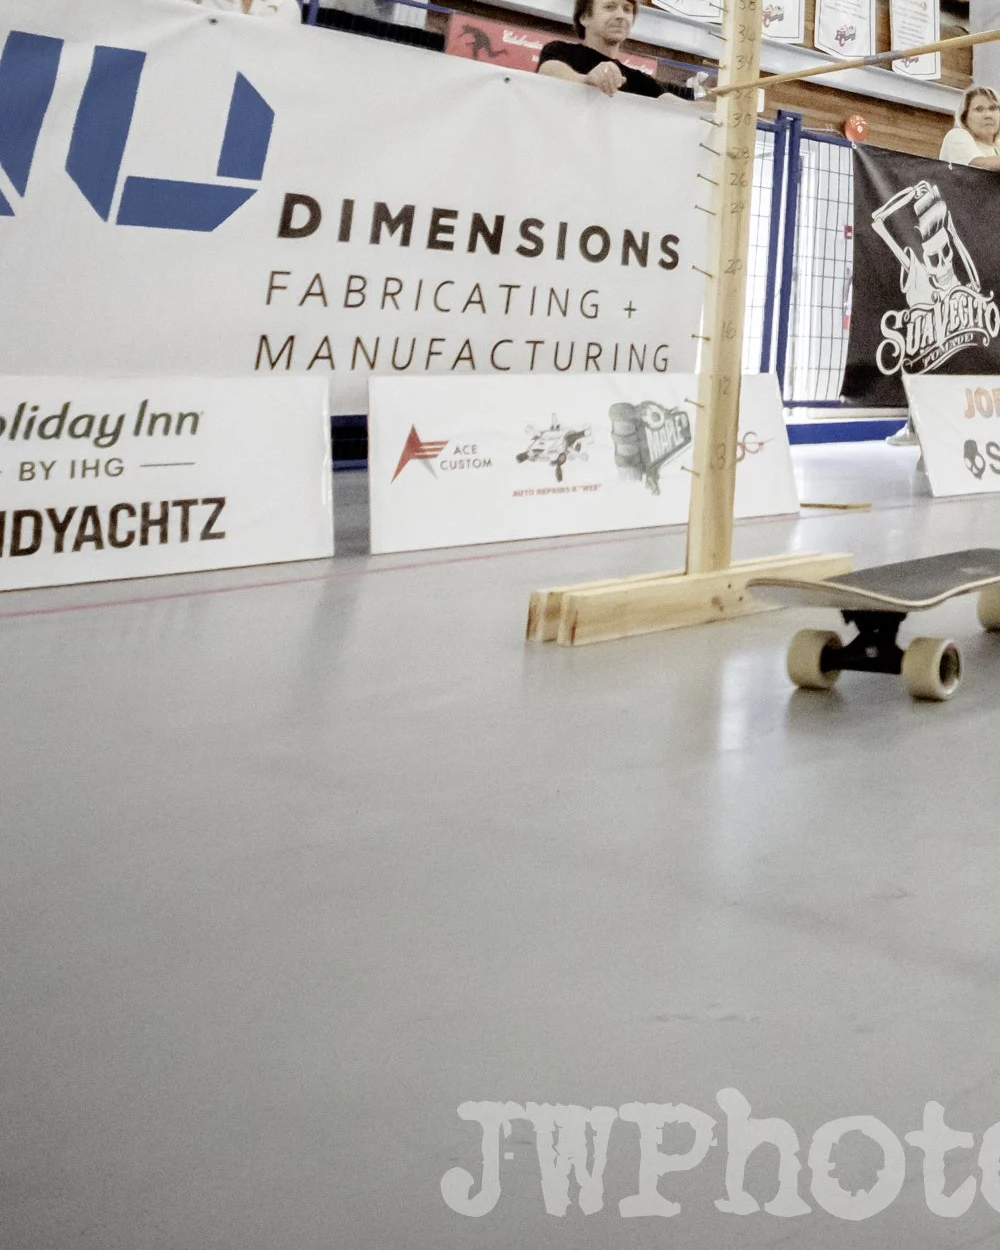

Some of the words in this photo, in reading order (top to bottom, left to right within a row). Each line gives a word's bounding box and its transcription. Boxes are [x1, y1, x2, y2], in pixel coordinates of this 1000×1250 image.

[735, 54, 754, 71] 34
[732, 113, 752, 128] 30
[729, 172, 749, 187] 26
[275, 191, 682, 271] DIMENSIONS
[265, 270, 601, 320] FABRICATING
[720, 320, 737, 340] 16
[254, 333, 672, 374] MANUFACTURING
[717, 376, 731, 396] 12
[132, 399, 201, 437] Inn
[453, 445, 478, 456] ACE
[18, 459, 57, 482] BY
[69, 457, 125, 480] IHG
[440, 457, 493, 472] CUSTOM
